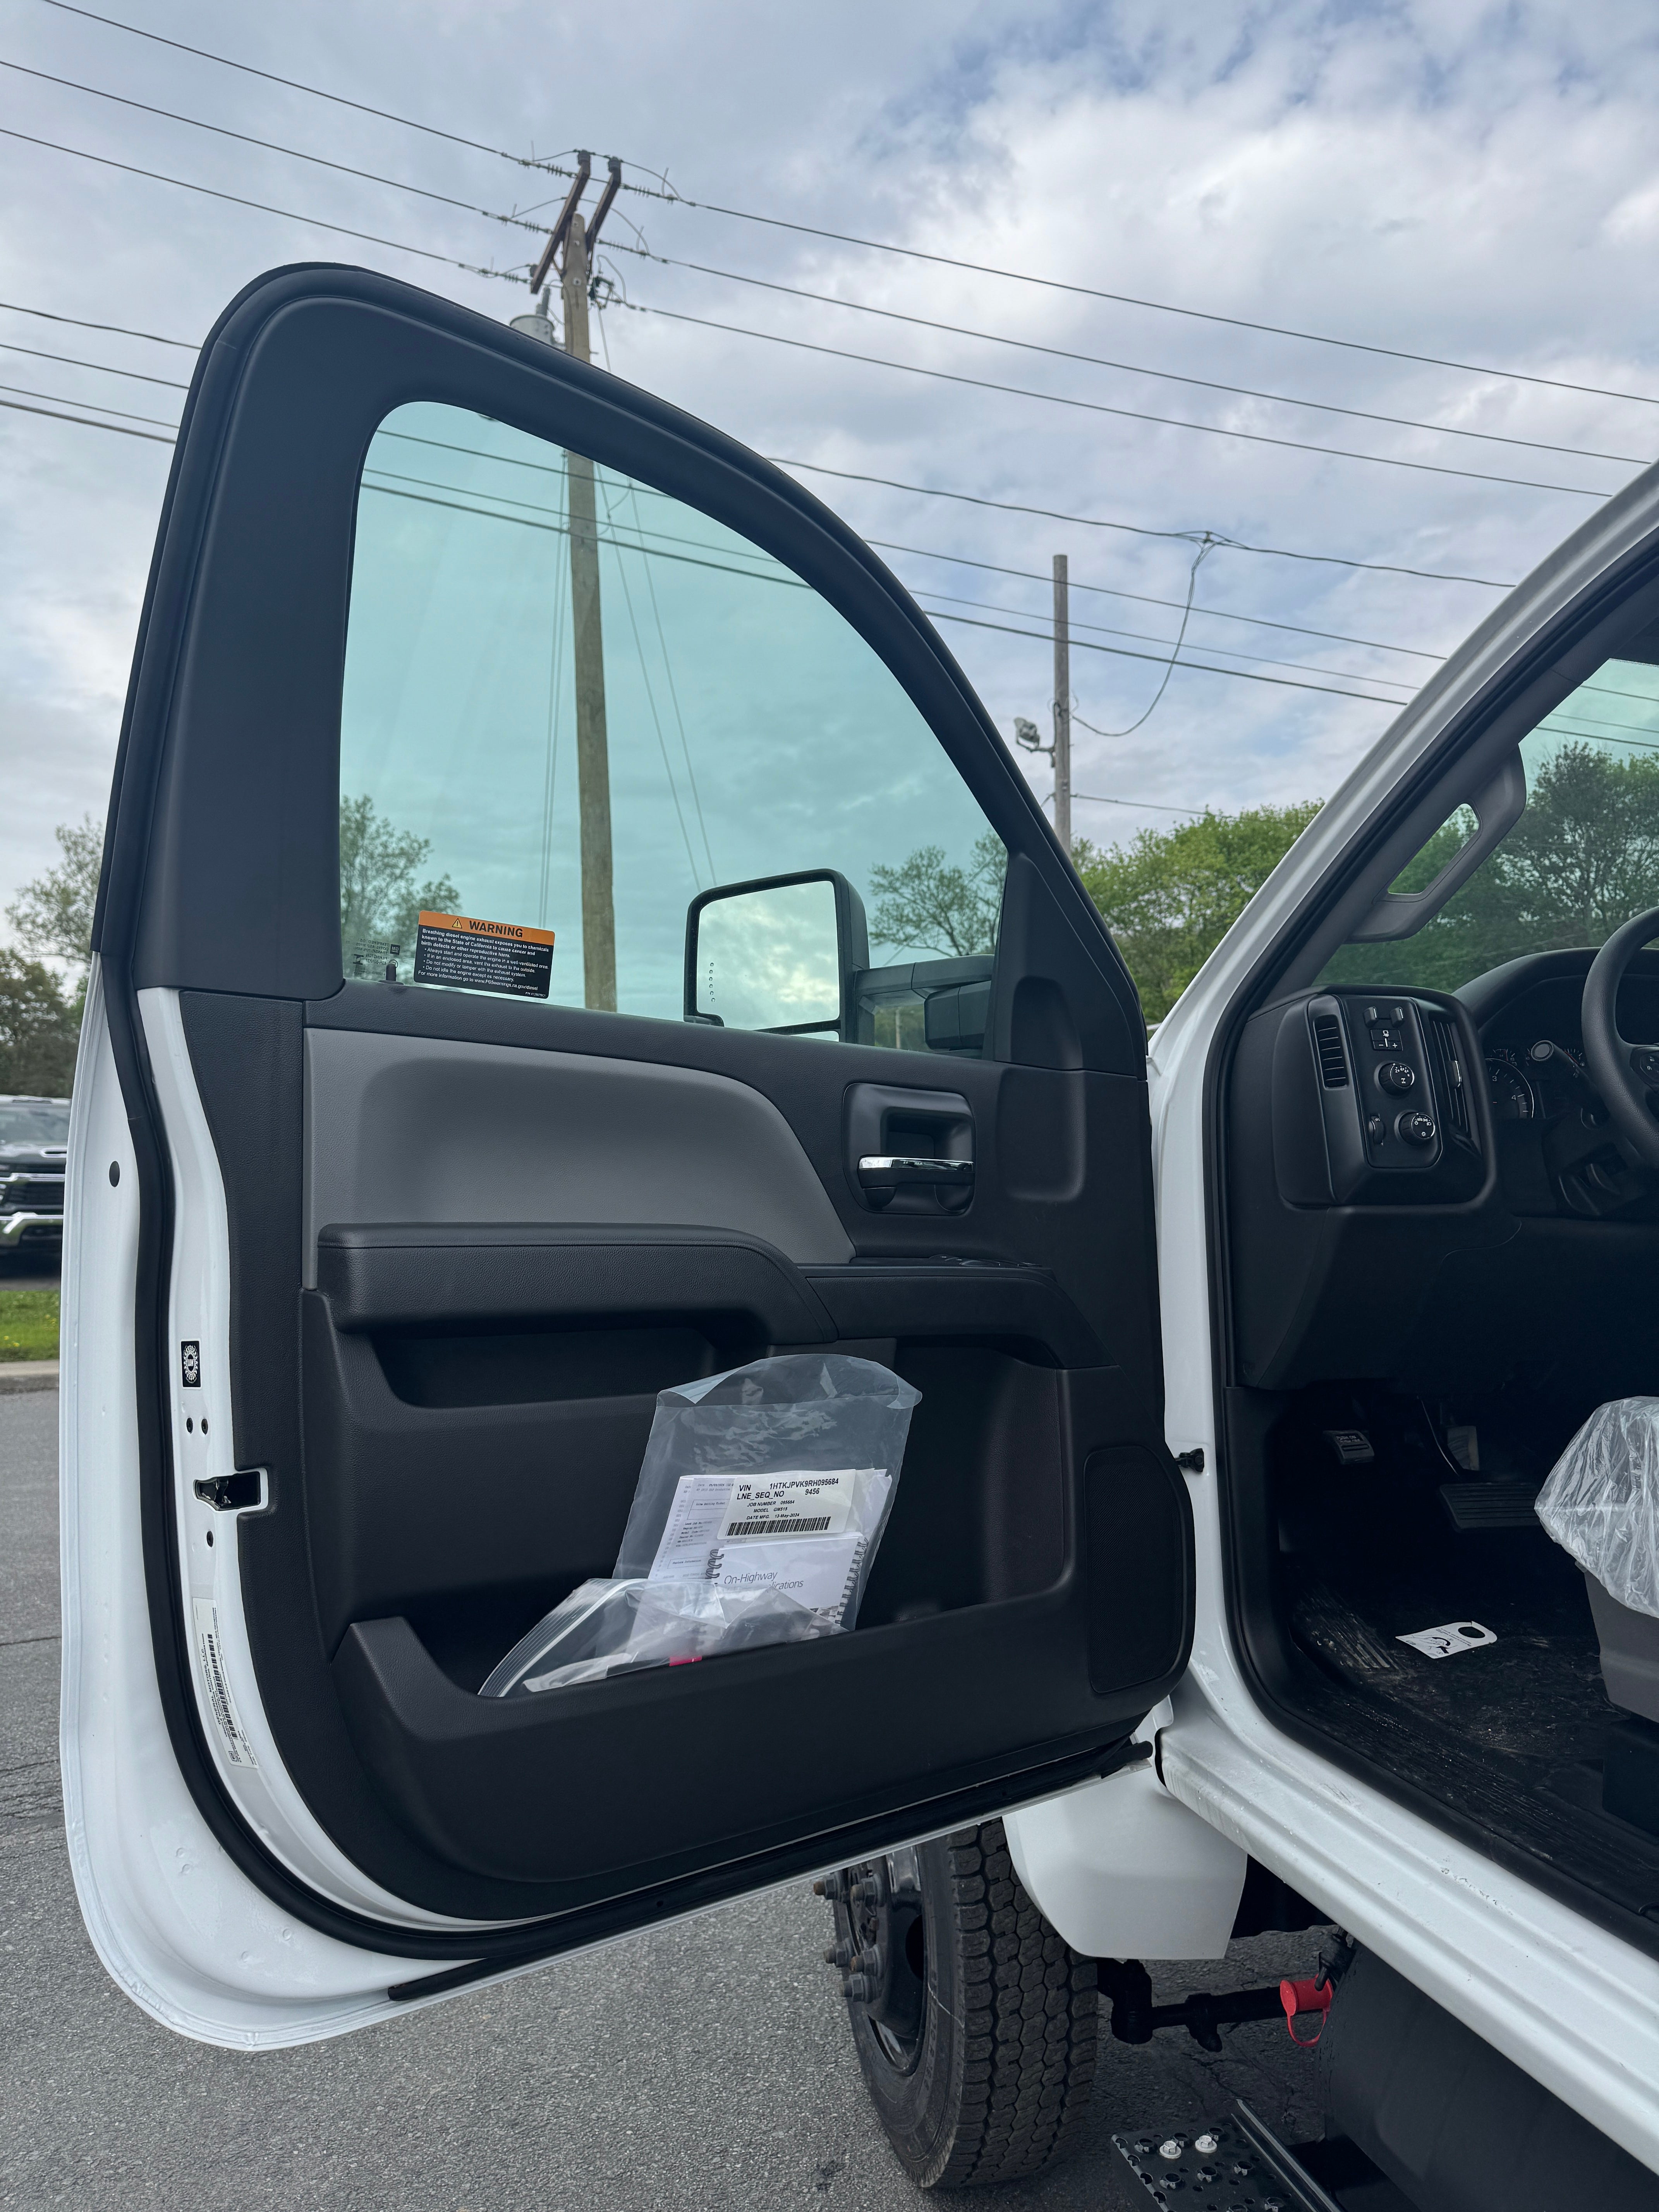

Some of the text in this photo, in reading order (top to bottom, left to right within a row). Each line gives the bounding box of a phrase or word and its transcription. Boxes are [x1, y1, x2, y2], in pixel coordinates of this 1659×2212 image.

[422, 928, 445, 936] Breathing
[469, 920, 523, 937] WARNING
[469, 948, 497, 957] reproductive
[769, 1478, 839, 1490] 1HTKJPVK9RH095684
[737, 1491, 785, 1501] LNE_SEQ_NO
[724, 1572, 778, 1584] On-Highway
[769, 1580, 804, 1590] lications
[211, 1696, 221, 1725] GENERAL
